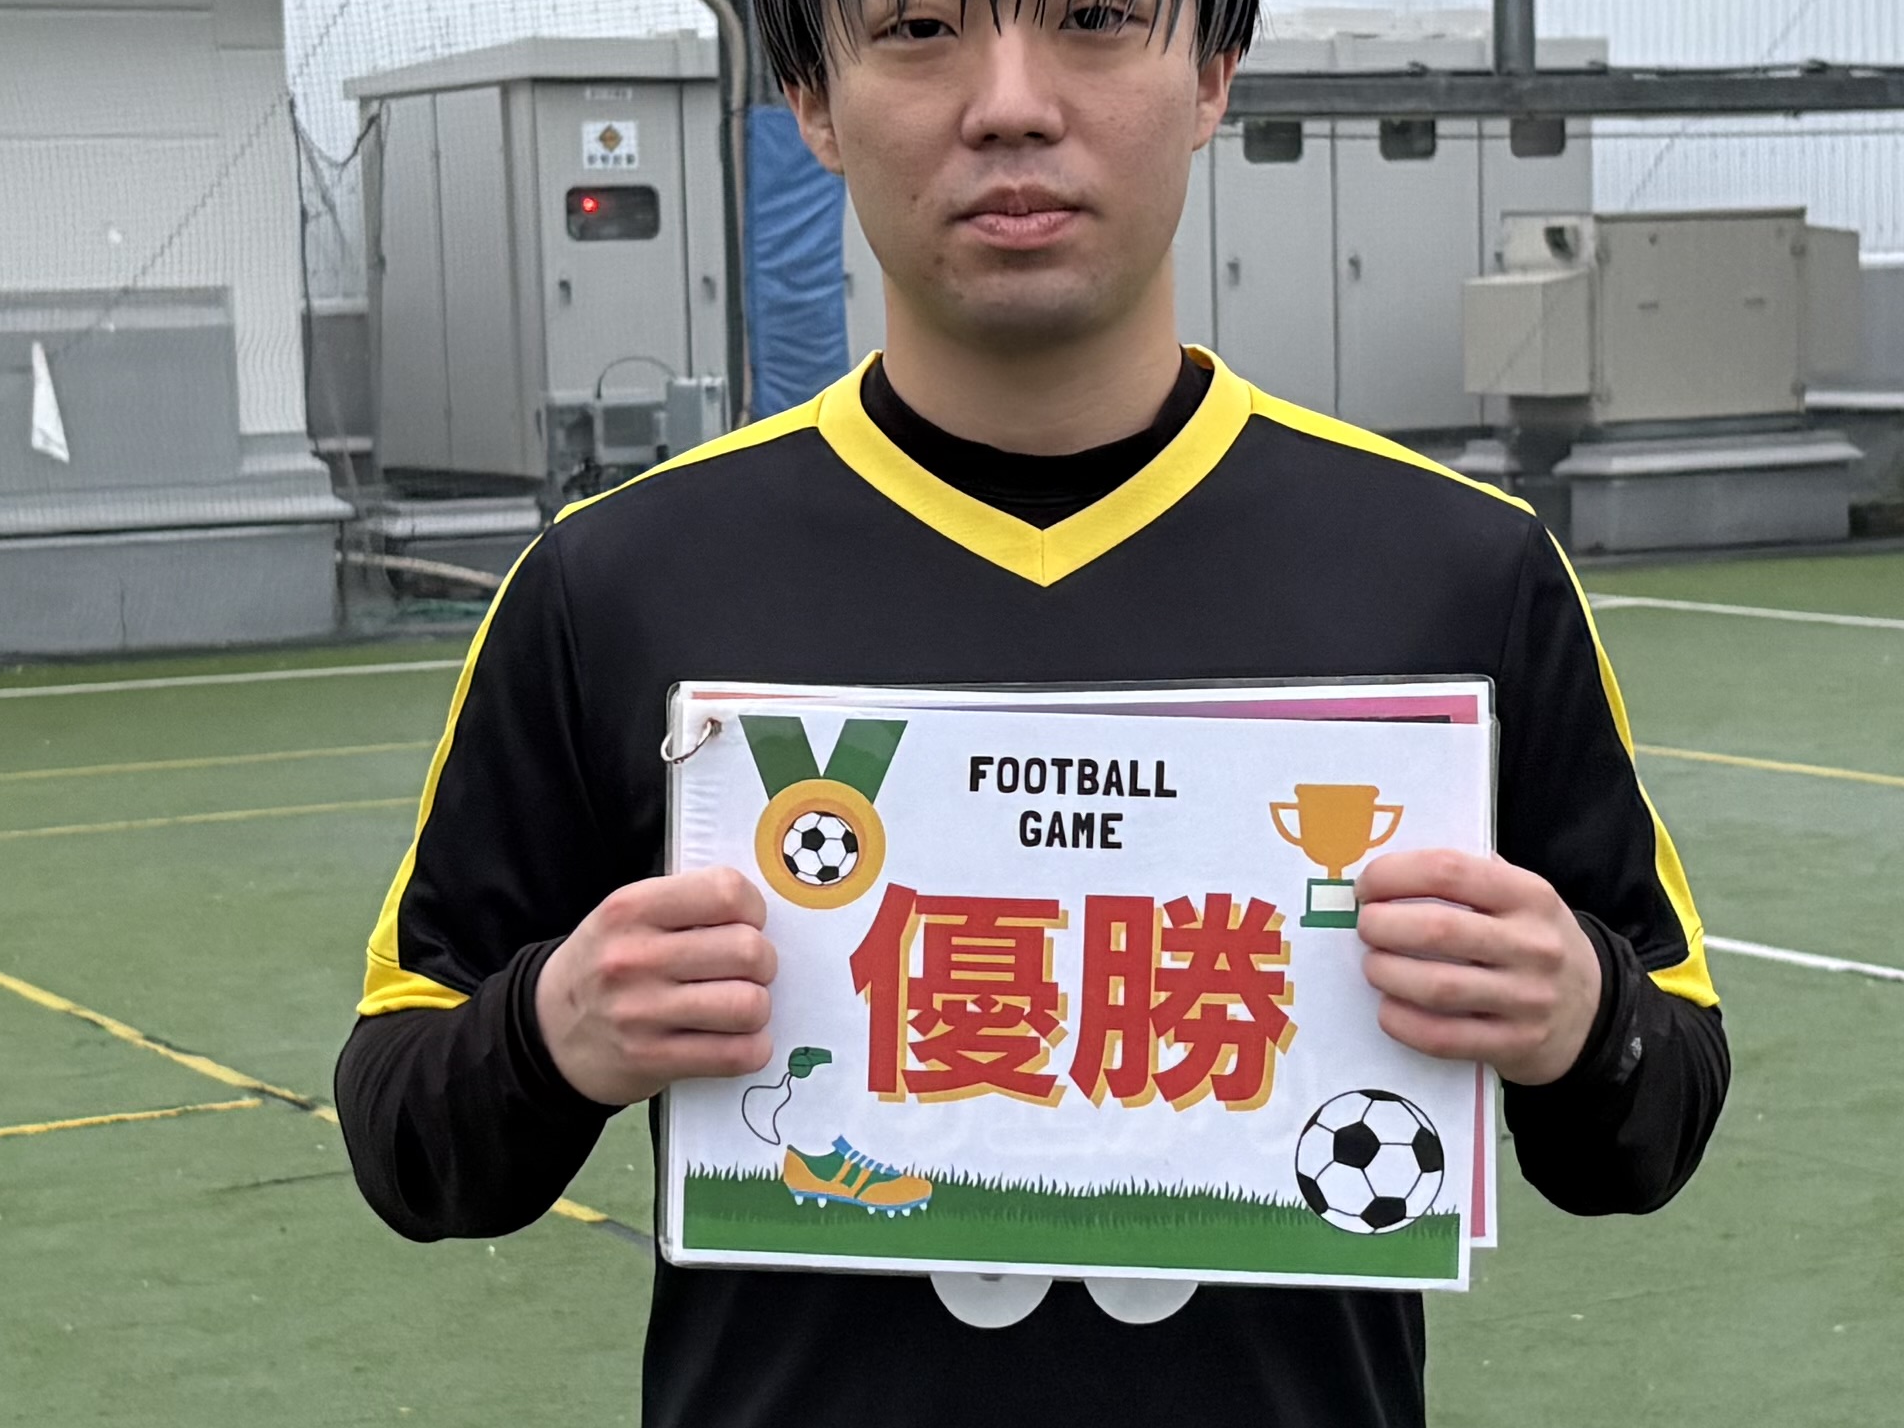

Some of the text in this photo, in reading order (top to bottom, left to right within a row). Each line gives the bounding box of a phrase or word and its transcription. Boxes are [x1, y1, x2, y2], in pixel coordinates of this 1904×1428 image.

[969, 756, 1177, 798] FOOTBALL
[1019, 810, 1123, 850] GAME
[849, 883, 1298, 1112] 優勝
